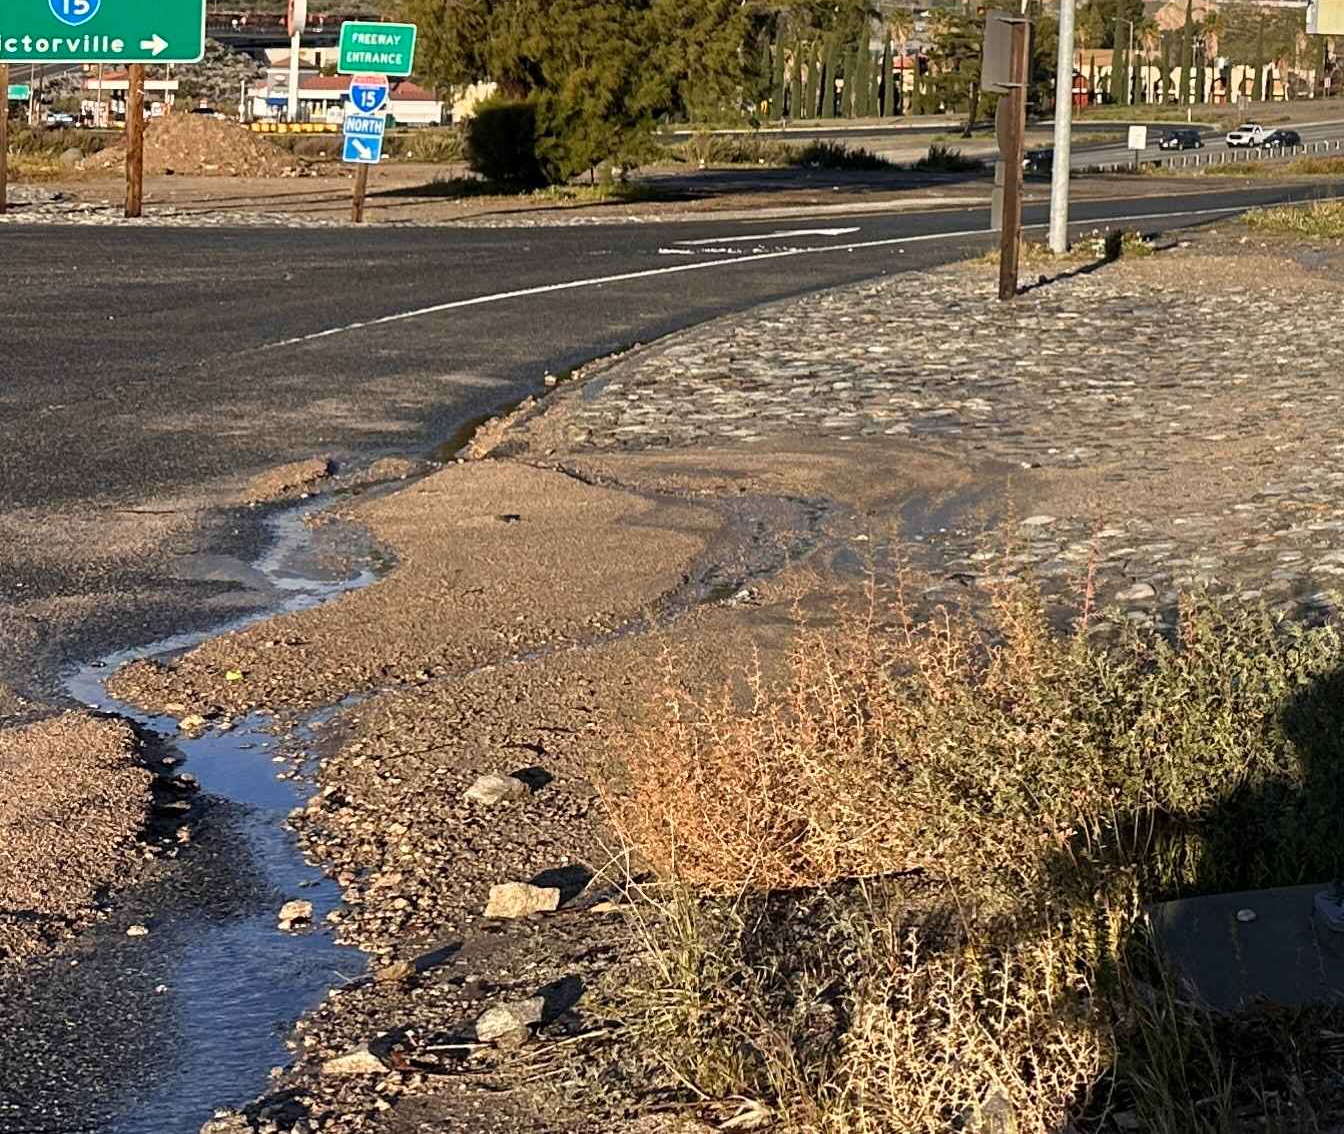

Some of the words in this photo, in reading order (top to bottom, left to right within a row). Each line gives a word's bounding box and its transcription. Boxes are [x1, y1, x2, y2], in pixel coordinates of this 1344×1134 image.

[352, 32, 402, 46] FREEWAY
[346, 50, 403, 65] ENTRANCE
[361, 90, 376, 108] 15
[346, 117, 383, 133] NORTH
